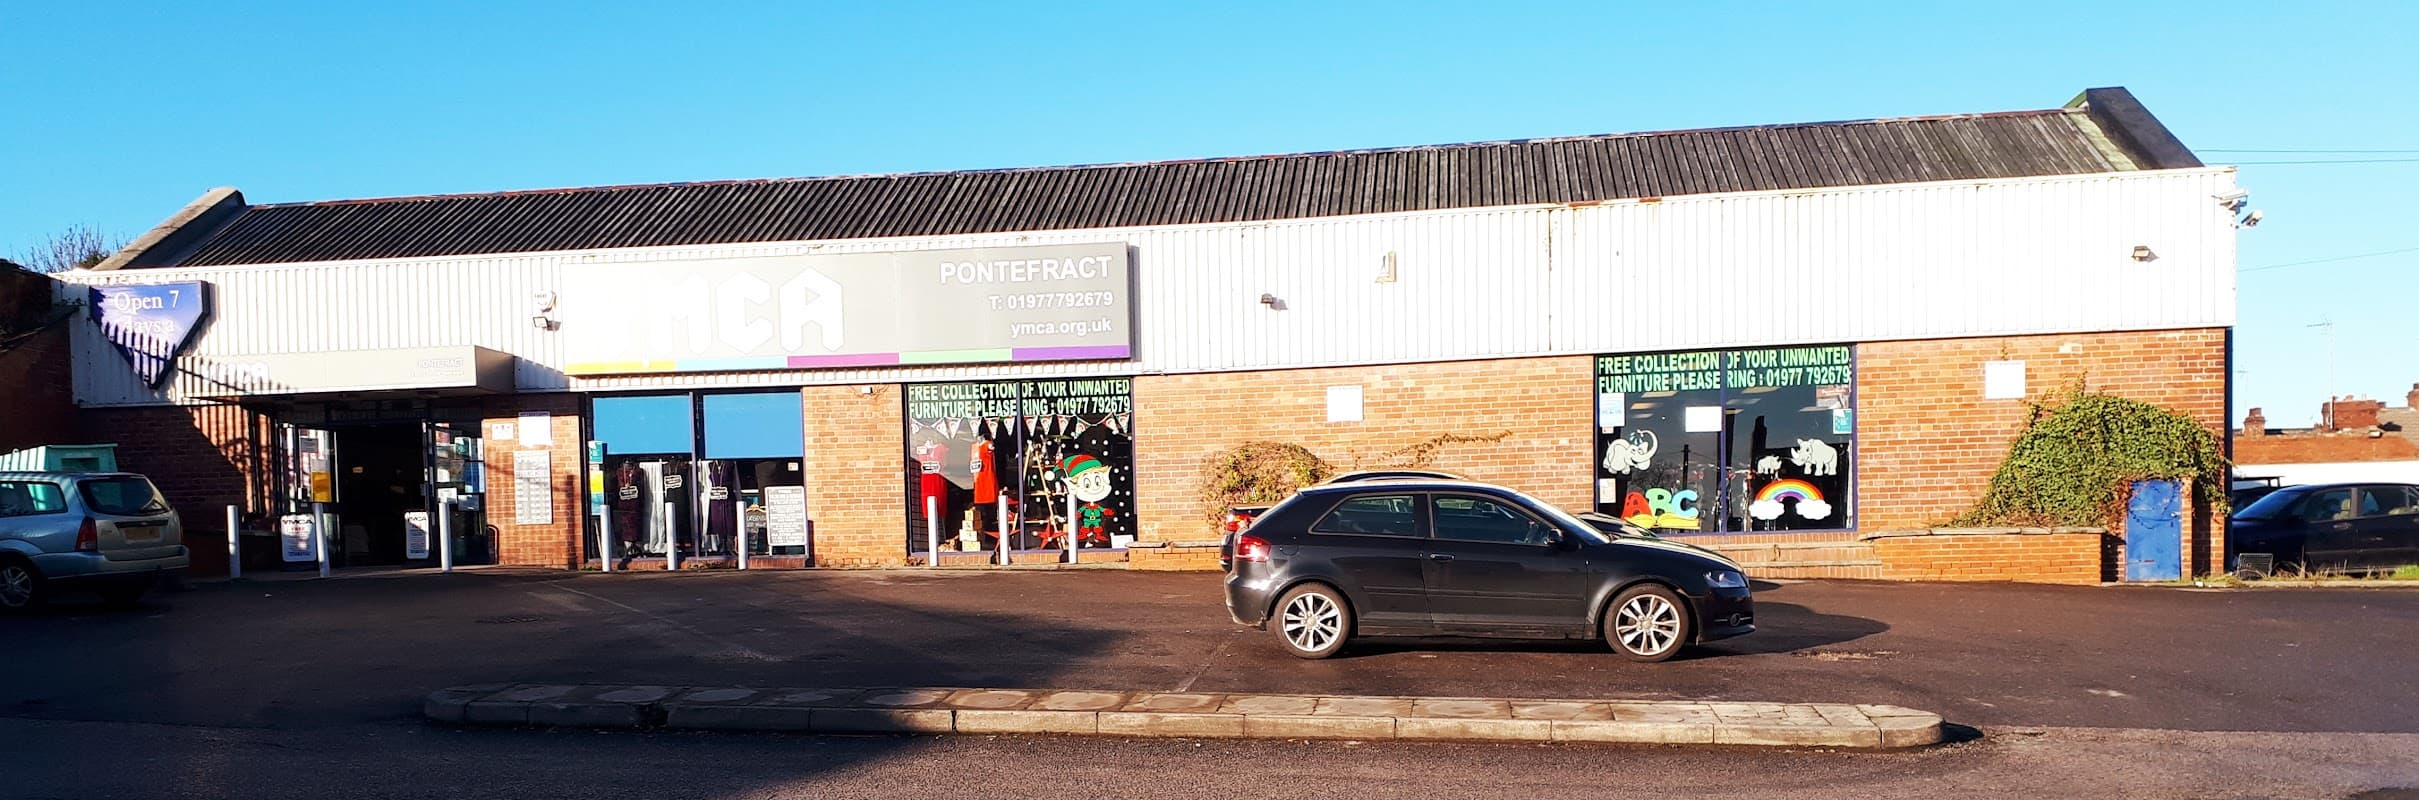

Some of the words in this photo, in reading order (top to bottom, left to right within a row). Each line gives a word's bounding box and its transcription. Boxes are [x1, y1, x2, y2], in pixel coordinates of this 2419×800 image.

[939, 255, 1113, 284] PONTEFRACT
[114, 292, 163, 315] Open
[168, 290, 179, 308] 7
[988, 296, 1003, 310] T:
[1007, 292, 1114, 309] 01977792679
[1010, 317, 1112, 338] ymca.org.uk
[1599, 357, 1631, 374] FREE
[1634, 351, 1720, 373] COLLECTION
[1744, 349, 1777, 369] YOUR
[1781, 346, 1850, 366] UNWANTED
[909, 385, 938, 400] FREE
[941, 383, 1017, 400] COLLECTION
[1022, 383, 1034, 398] OF
[1037, 381, 1067, 397] YOUR
[1069, 380, 1130, 395] UNWANTED
[1599, 374, 1669, 393] FURNITURE
[1673, 371, 1720, 391] PLEASE
[1727, 368, 1756, 388] RING
[1766, 367, 1803, 387] 01977
[1806, 365, 1850, 384] 792679
[910, 401, 972, 418] FURNITURE
[975, 399, 1017, 416] PLEASE
[1022, 399, 1048, 416] RING
[1057, 397, 1089, 414] 01977
[1091, 395, 1131, 413] 792679
[1621, 488, 1699, 519] ABC
